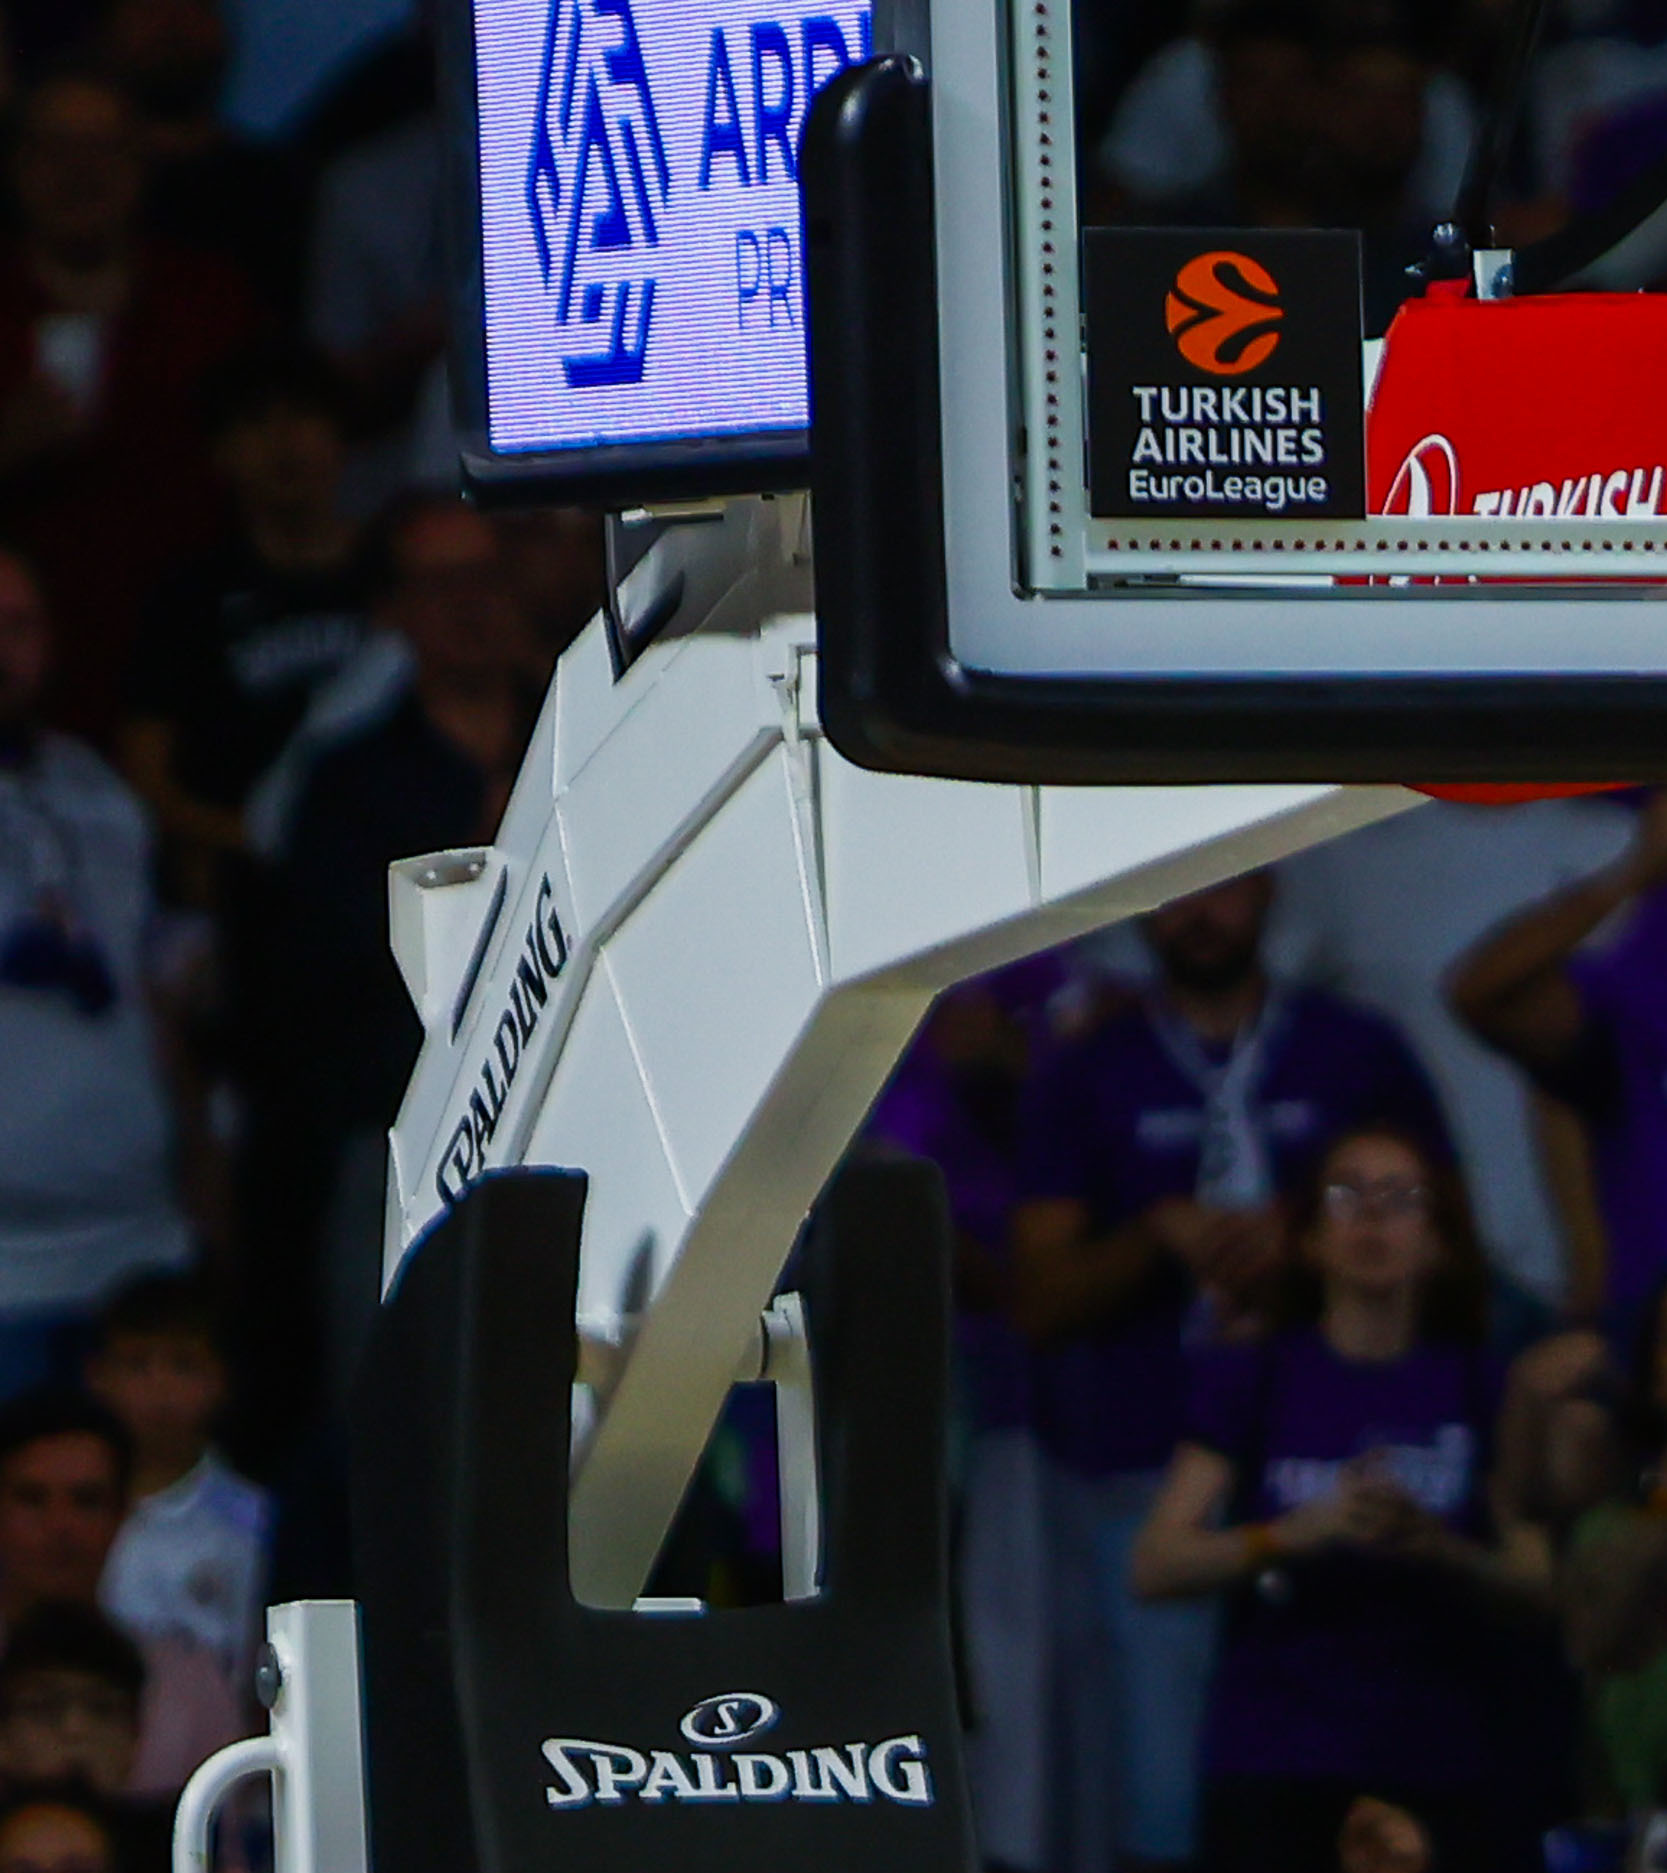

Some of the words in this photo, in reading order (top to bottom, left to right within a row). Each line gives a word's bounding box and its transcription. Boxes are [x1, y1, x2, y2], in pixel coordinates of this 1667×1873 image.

[1131, 386, 1320, 423] TURKISH
[1131, 427, 1325, 464] AIRLINES
[1128, 468, 1329, 510] EuroLeague
[540, 1734, 930, 1805] SPALDING
